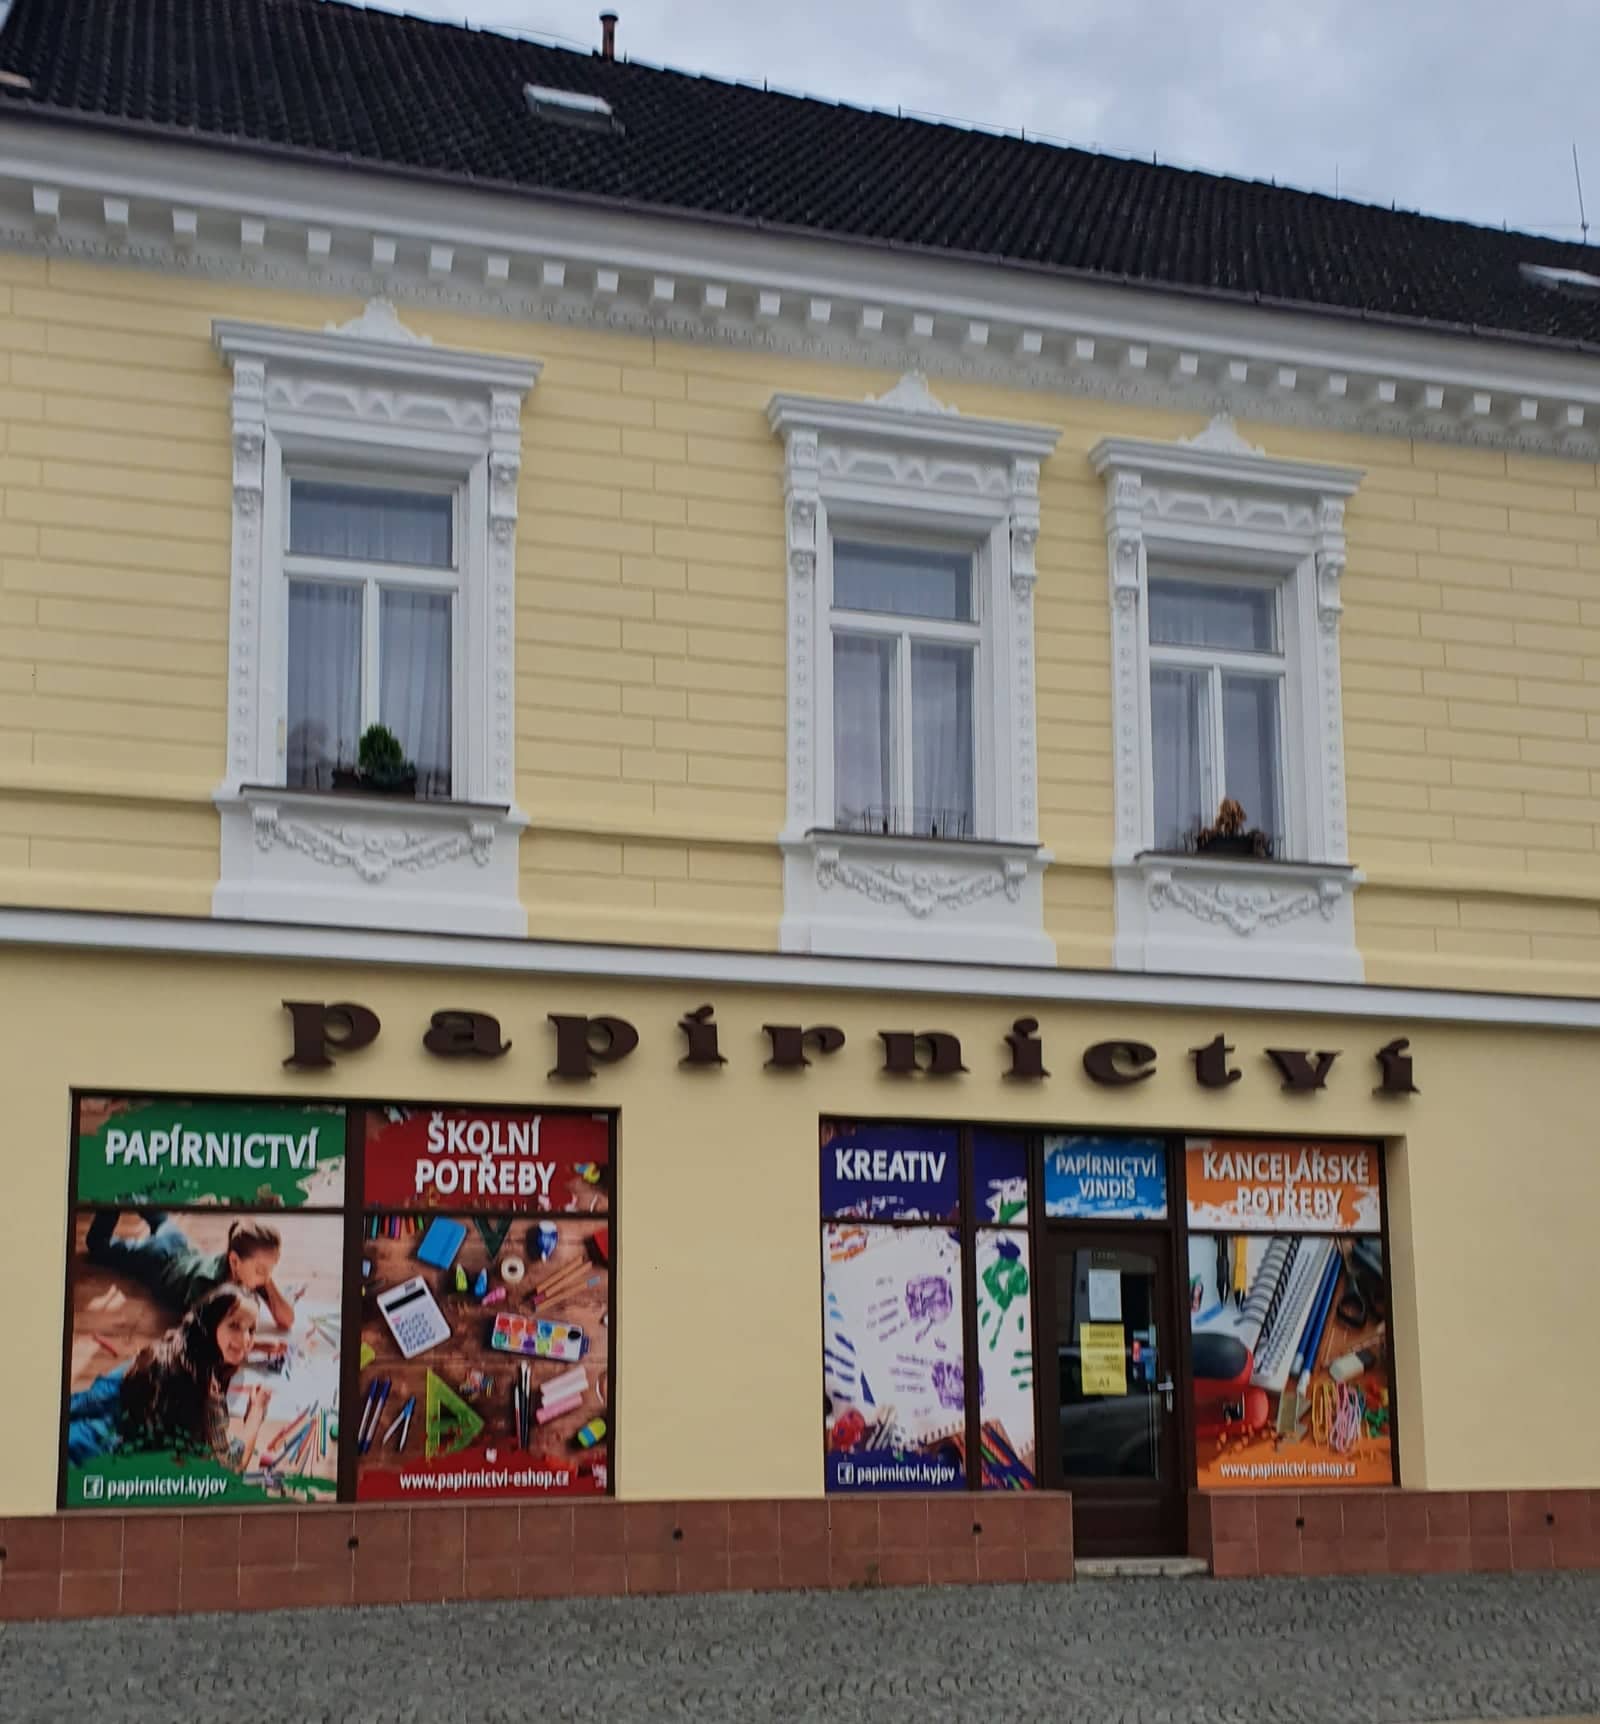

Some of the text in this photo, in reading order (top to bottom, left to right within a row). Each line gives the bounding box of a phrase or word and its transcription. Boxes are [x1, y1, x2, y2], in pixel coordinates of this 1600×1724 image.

[105, 1123, 320, 1168] PAPÍRNICTVÍ
[427, 1112, 541, 1156] ŠKOLNÍ
[415, 1152, 556, 1195] POTŘEBY
[835, 1148, 946, 1183] KREATIV
[1055, 1151, 1157, 1176] PAPÍRNICTVÍ
[1202, 1148, 1369, 1184] KANCELÁŘSKÉ
[1077, 1172, 1136, 1200] VINDIŠ
[1236, 1178, 1343, 1219] POTŘEBY
[107, 1474, 228, 1500] papirnictvi.kyjov
[399, 1467, 569, 1492] www.papirnictvi-eshop.cz
[857, 1463, 956, 1485] papirnictvi.kyjov
